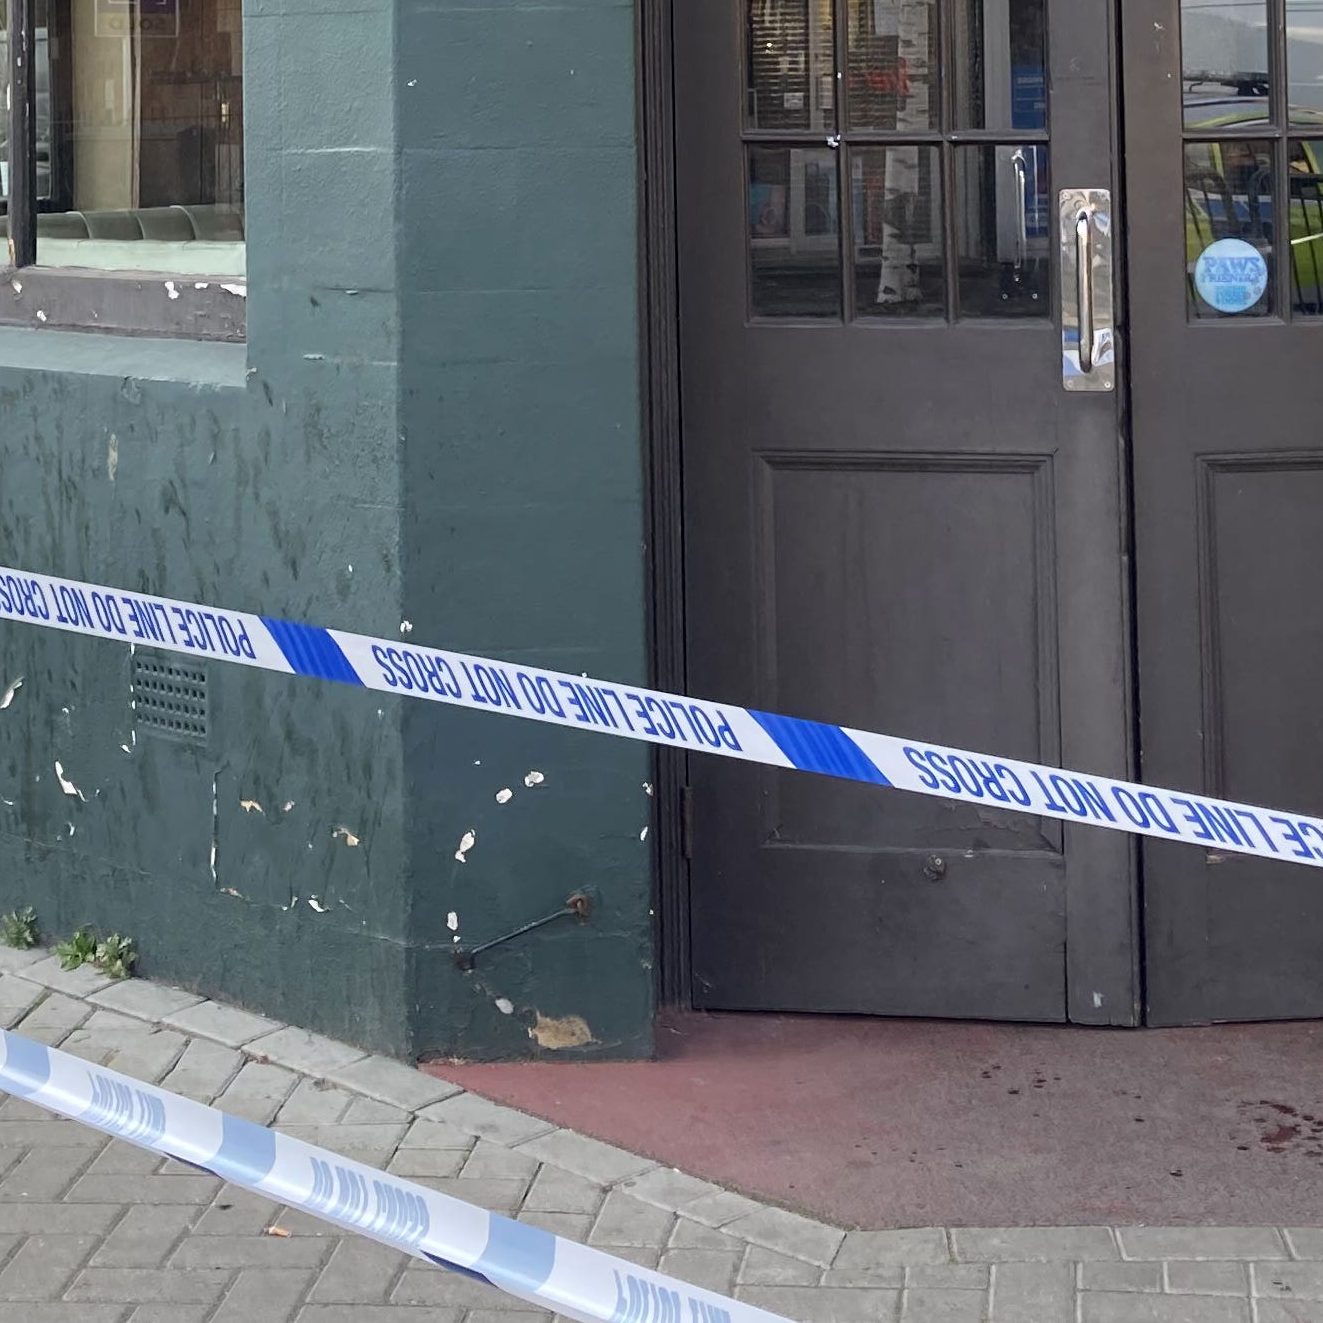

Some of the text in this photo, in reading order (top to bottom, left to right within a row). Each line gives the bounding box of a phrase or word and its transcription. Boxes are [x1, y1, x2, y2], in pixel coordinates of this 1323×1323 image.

[53, 584, 95, 627] NOT
[90, 591, 128, 637] DO
[121, 596, 176, 644] LINE
[171, 606, 258, 661] POLICE
[371, 644, 743, 753] POLICE LINE DO NOT CROSS
[901, 745, 1033, 808] CROSS
[1031, 770, 1117, 823] NOT
[1109, 785, 1181, 835] DO
[1170, 795, 1279, 853] LINE
